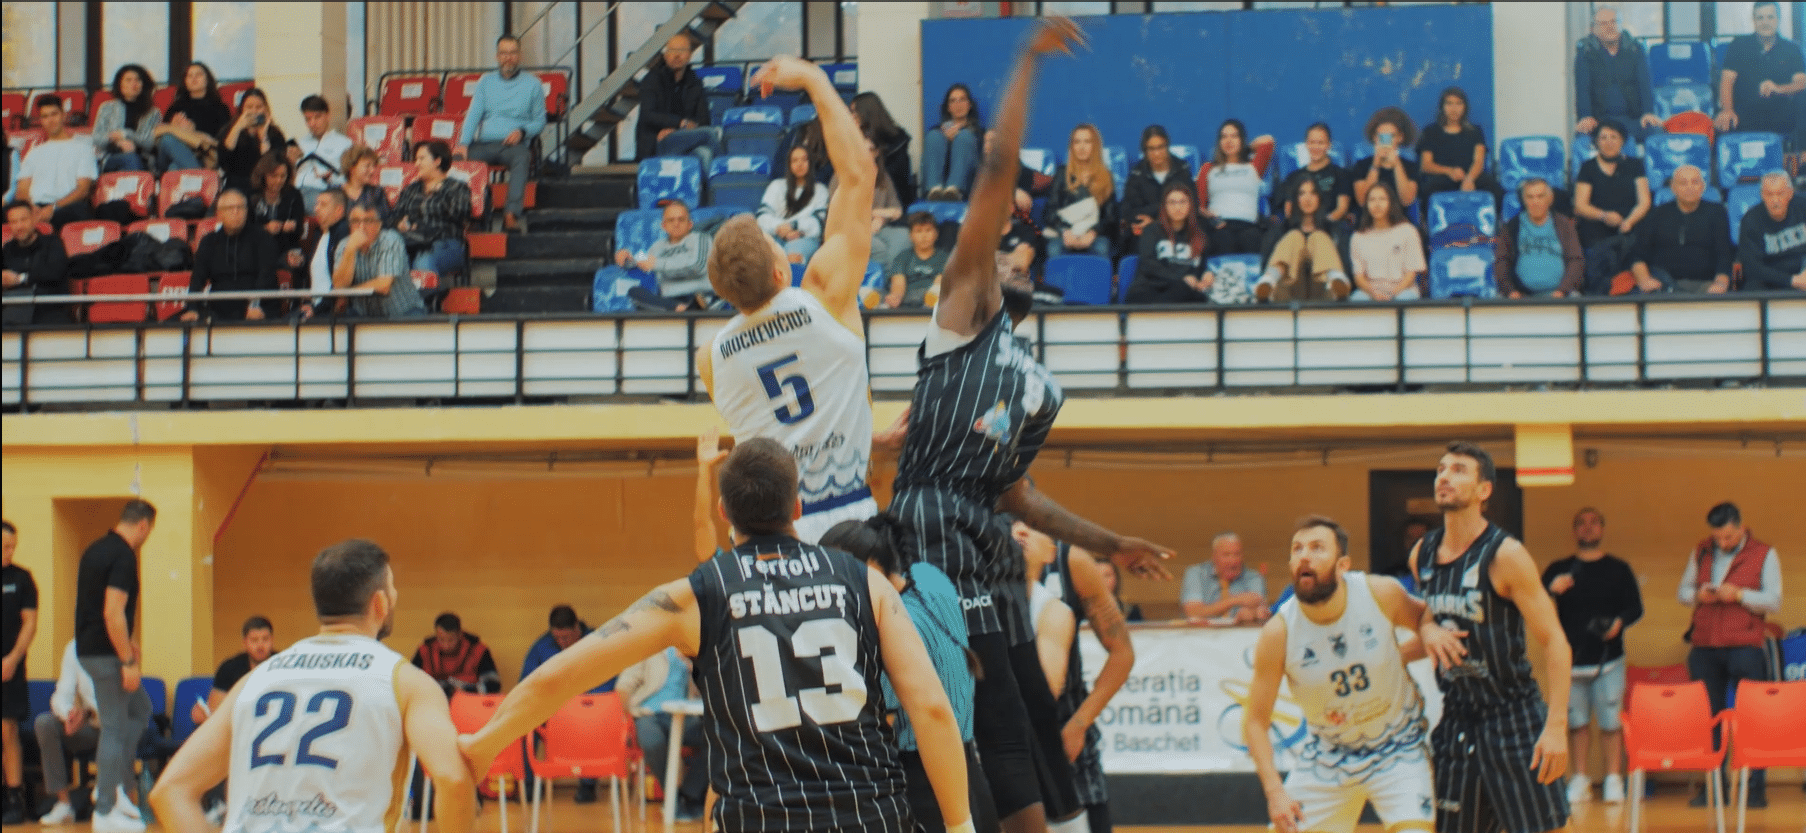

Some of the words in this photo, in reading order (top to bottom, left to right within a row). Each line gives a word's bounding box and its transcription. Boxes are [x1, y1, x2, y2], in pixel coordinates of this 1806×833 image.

[756, 352, 815, 426] 5
[738, 618, 867, 732] 13
[1330, 663, 1371, 697] 33
[250, 689, 352, 770] 22
[1100, 697, 1201, 725] omână
[1114, 731, 1201, 753] Baschet
